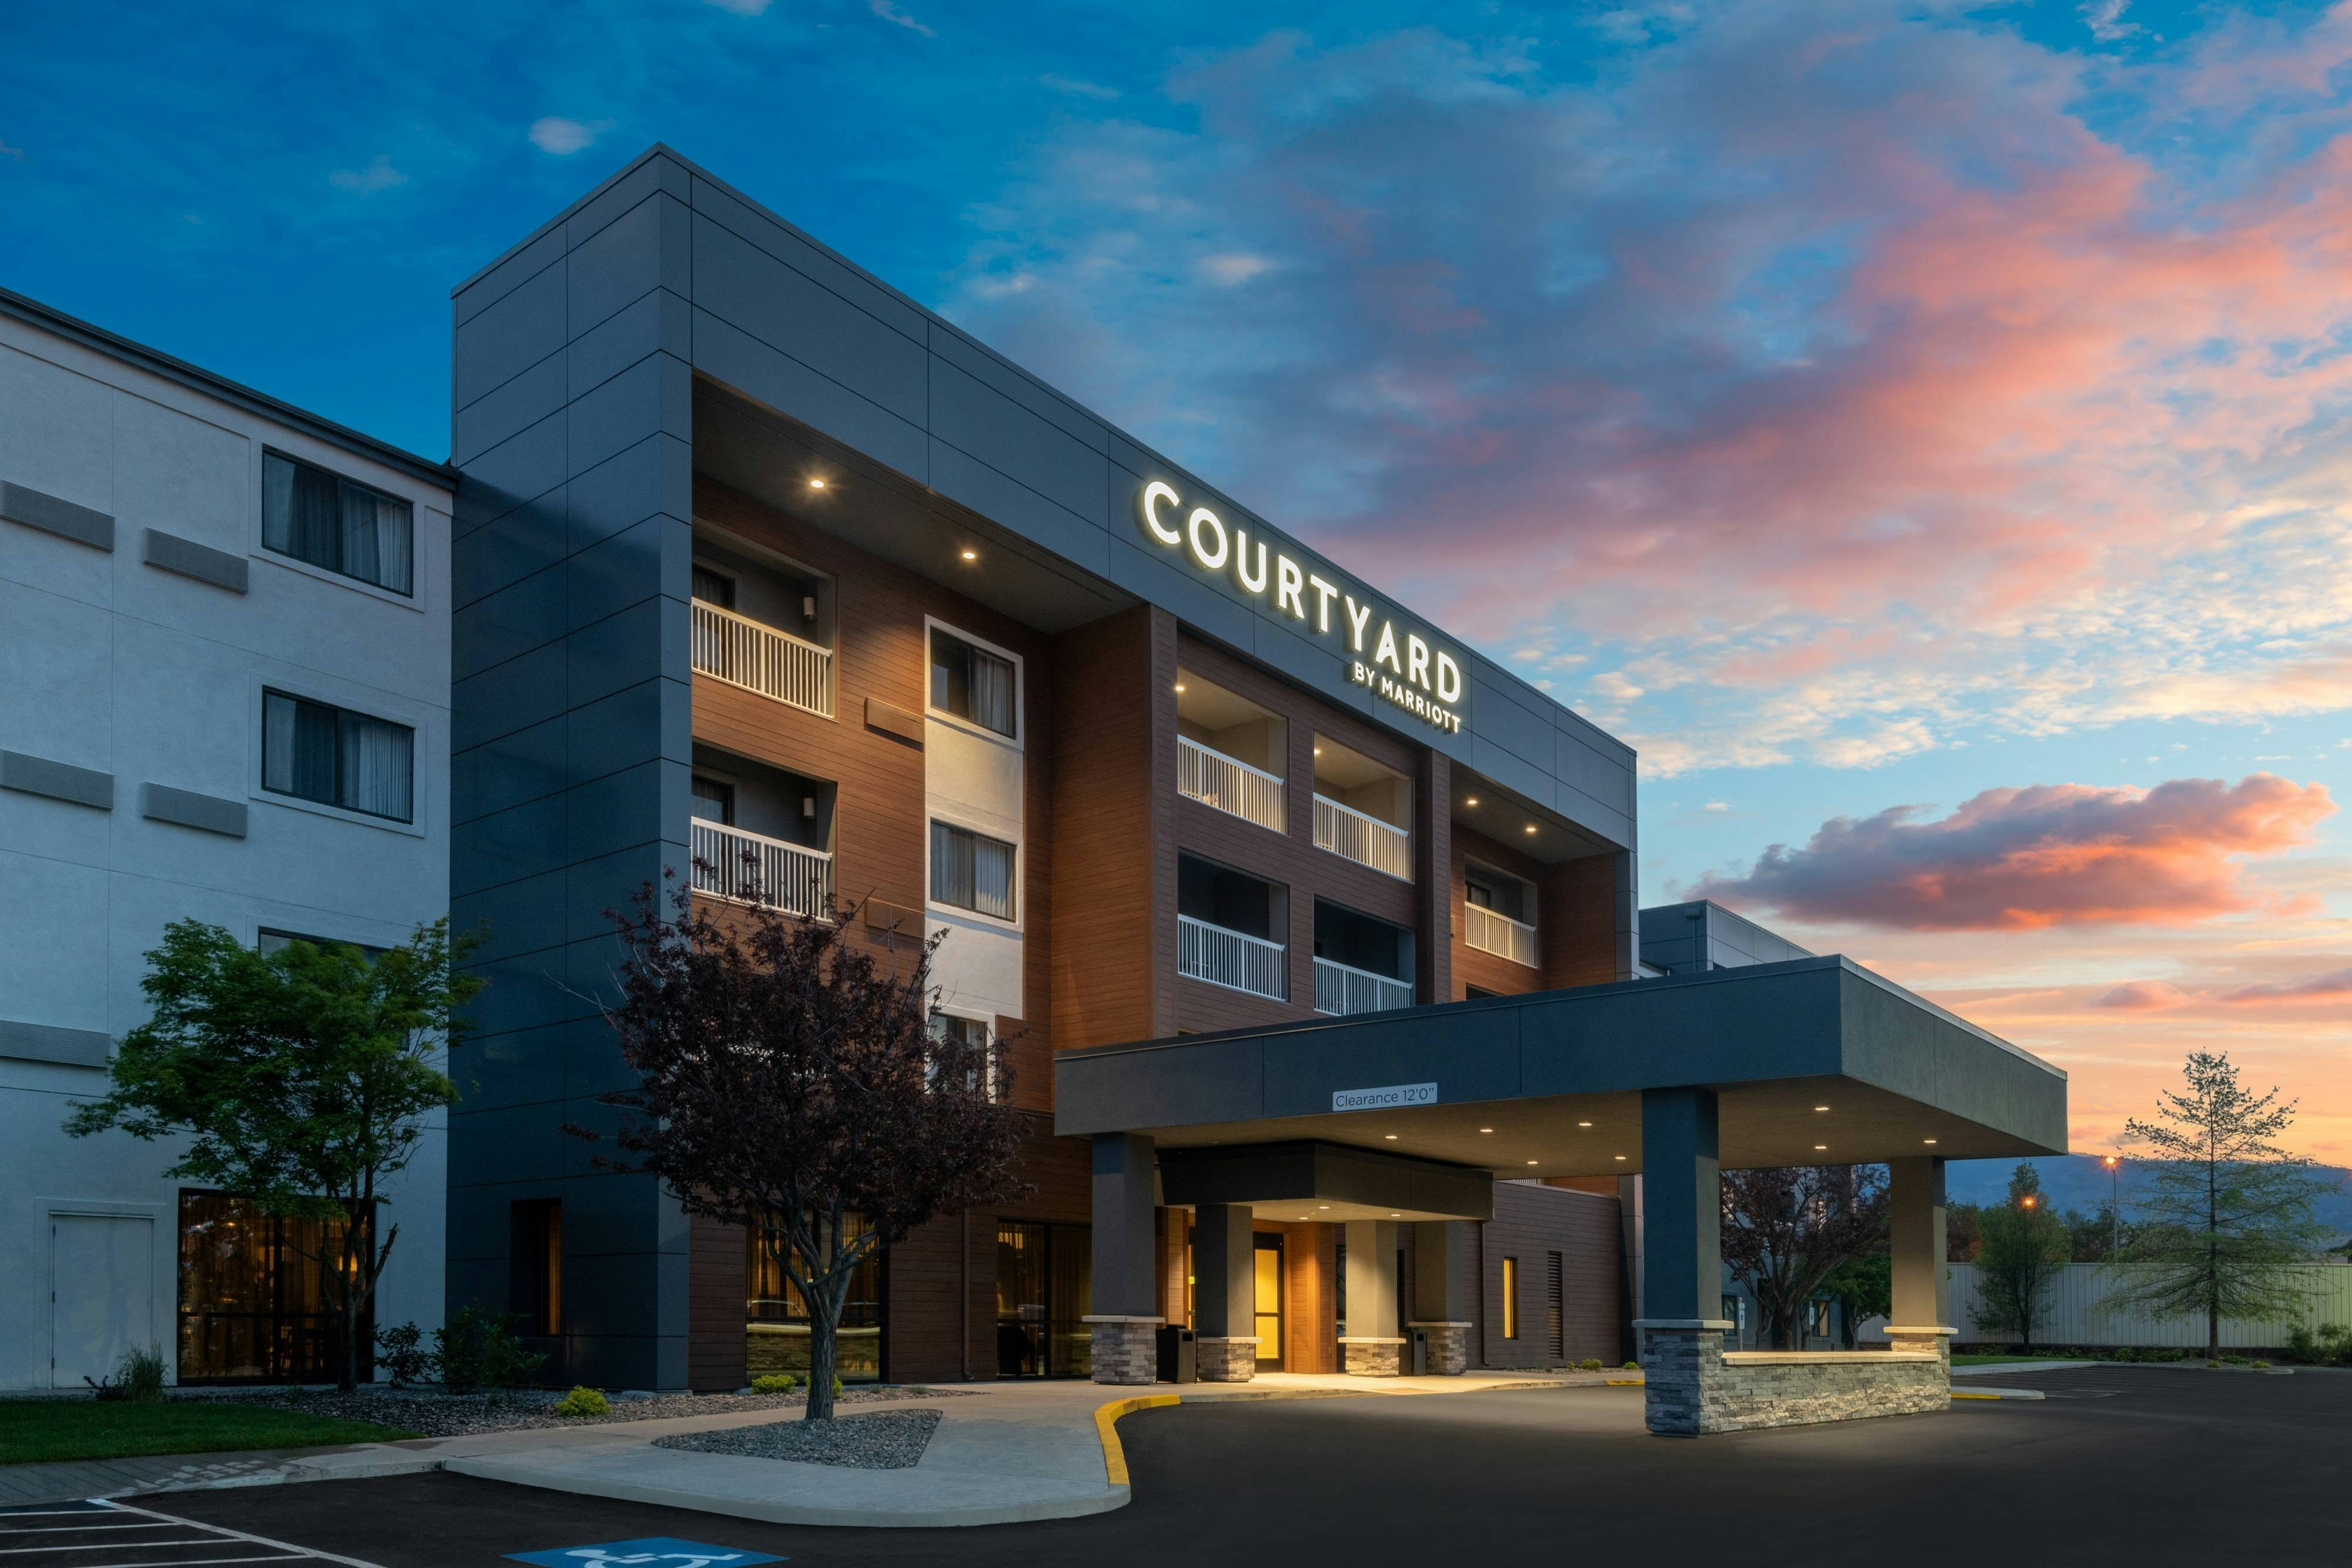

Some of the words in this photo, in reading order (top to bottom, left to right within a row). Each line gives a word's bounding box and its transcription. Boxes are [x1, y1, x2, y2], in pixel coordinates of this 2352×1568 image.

[1144, 481, 1461, 704] COURTYARD
[1354, 661, 1376, 687] BY
[1382, 676, 1461, 734] MARRIOTT
[1336, 1092, 1398, 1107] Clearance
